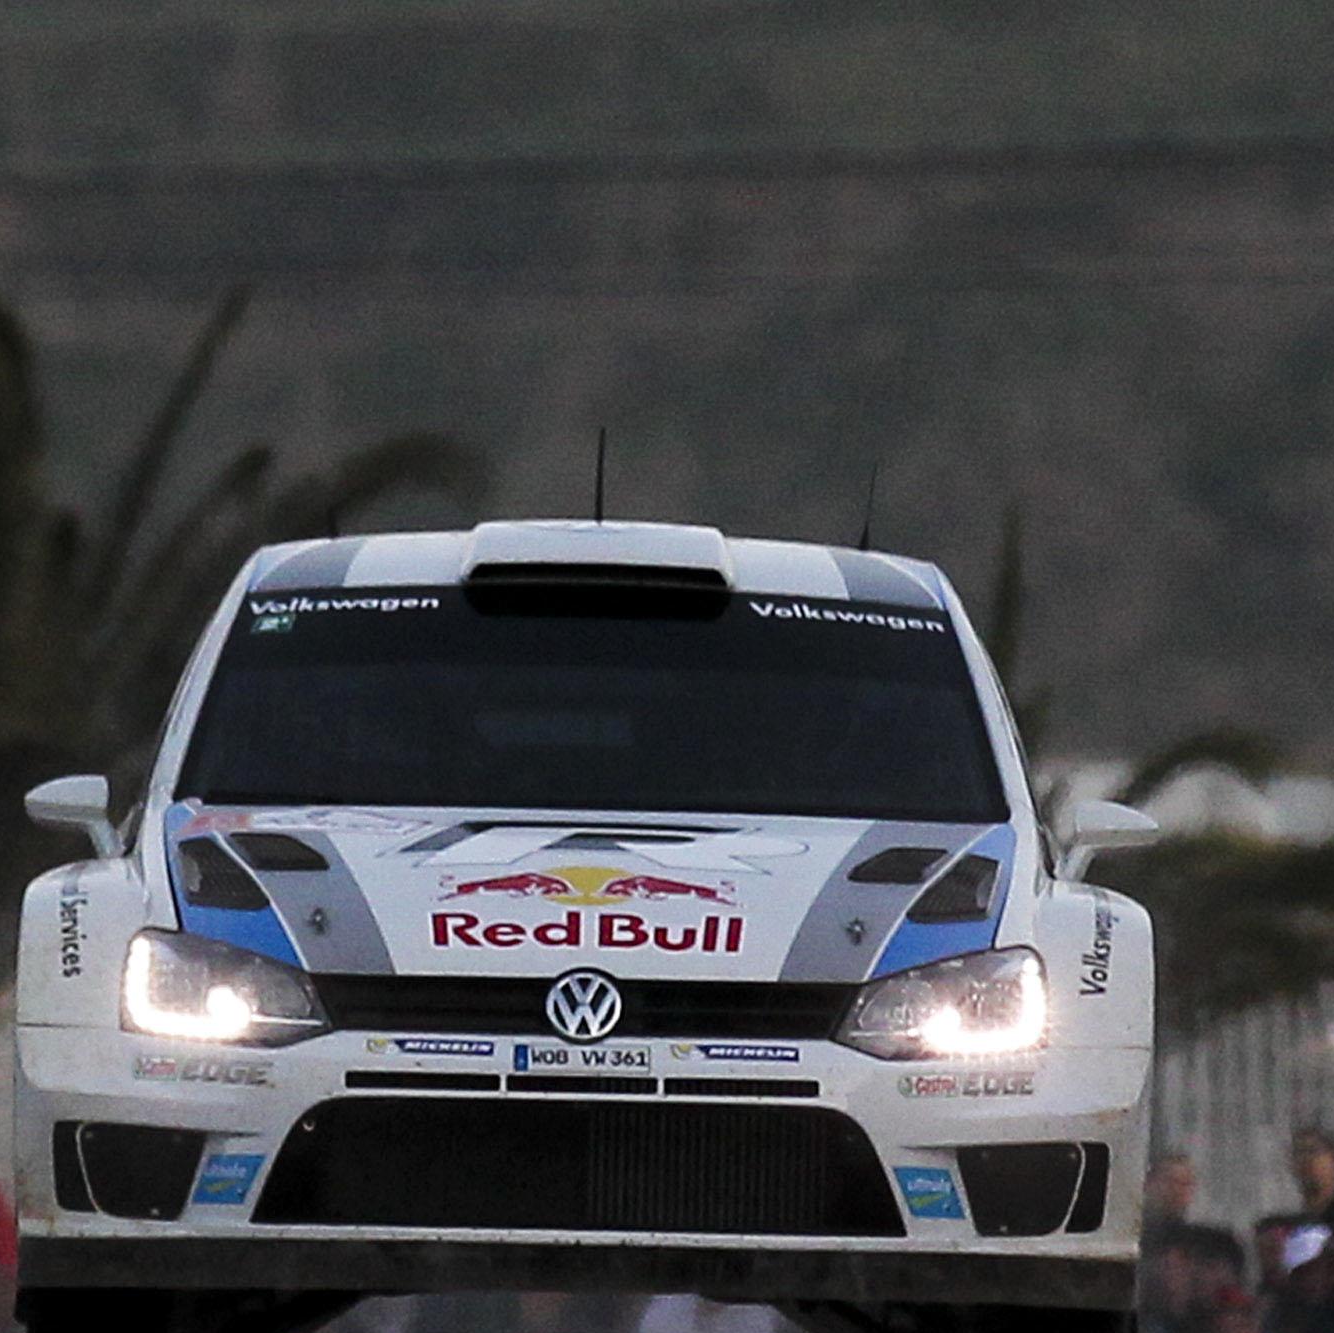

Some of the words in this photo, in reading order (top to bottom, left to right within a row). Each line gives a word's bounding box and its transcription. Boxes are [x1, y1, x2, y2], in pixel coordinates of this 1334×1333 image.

[250, 597, 440, 615] Volkswagen
[749, 601, 946, 633] Volkswagen
[431, 911, 581, 947] Red
[598, 913, 743, 953] Bull
[402, 1040, 493, 1055] MICHELIN
[531, 1047, 568, 1066] WOB
[581, 1050, 607, 1067] VW
[609, 1050, 647, 1067] 361
[710, 1047, 797, 1061] MICHELIN
